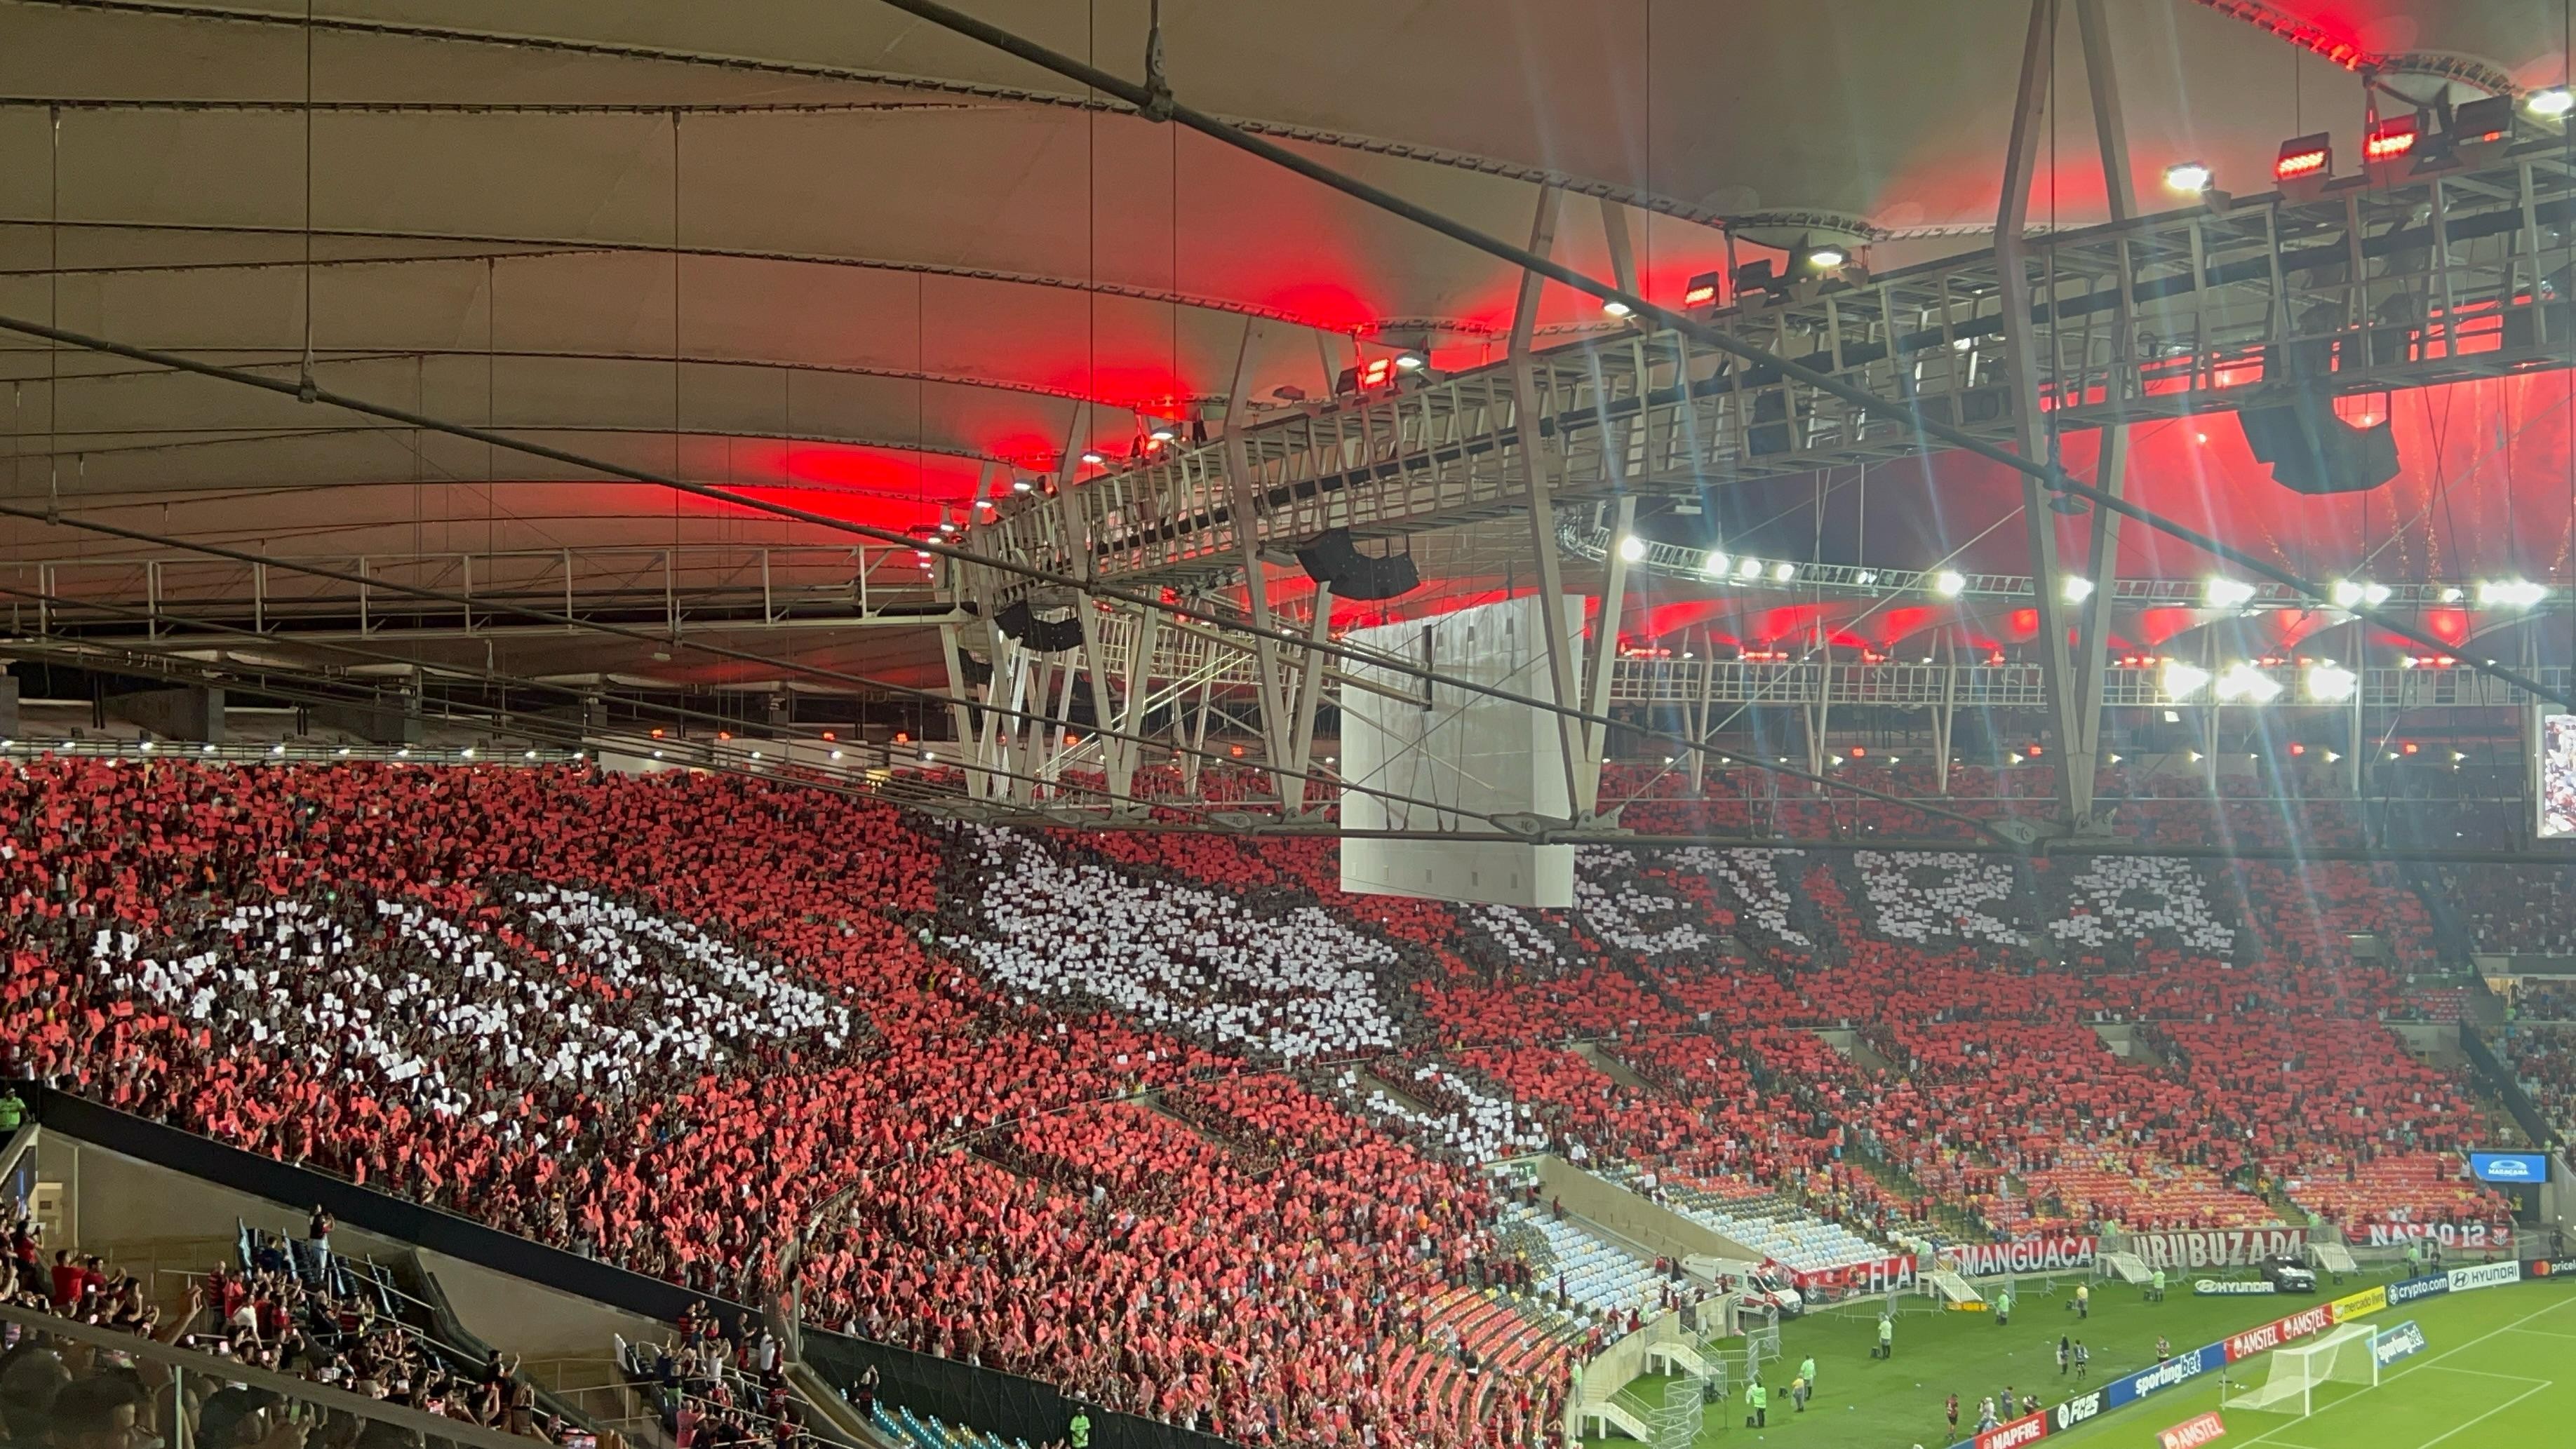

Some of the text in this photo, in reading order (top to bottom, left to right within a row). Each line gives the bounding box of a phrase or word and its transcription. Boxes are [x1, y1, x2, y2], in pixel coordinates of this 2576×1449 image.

[2133, 1230, 2302, 1267] URUBUZADA
[2461, 1225, 2485, 1246] 12
[1870, 1255, 1912, 1293] FLA
[2218, 1282, 2274, 1293] HYUNDAI
[2399, 1276, 2448, 1299] crypto.com
[2471, 1265, 2518, 1283] HYUNDAI
[2344, 1290, 2384, 1314] mercado livre
[2292, 1308, 2327, 1335] AMSTEL
[2243, 1326, 2279, 1354] AMSTEL
[2377, 1324, 2424, 1363] sportingbet
[2135, 1349, 2201, 1397] sportingbet
[1992, 1419, 2041, 1449] MAPFRE
[2178, 1416, 2224, 1448] AMSTEL
